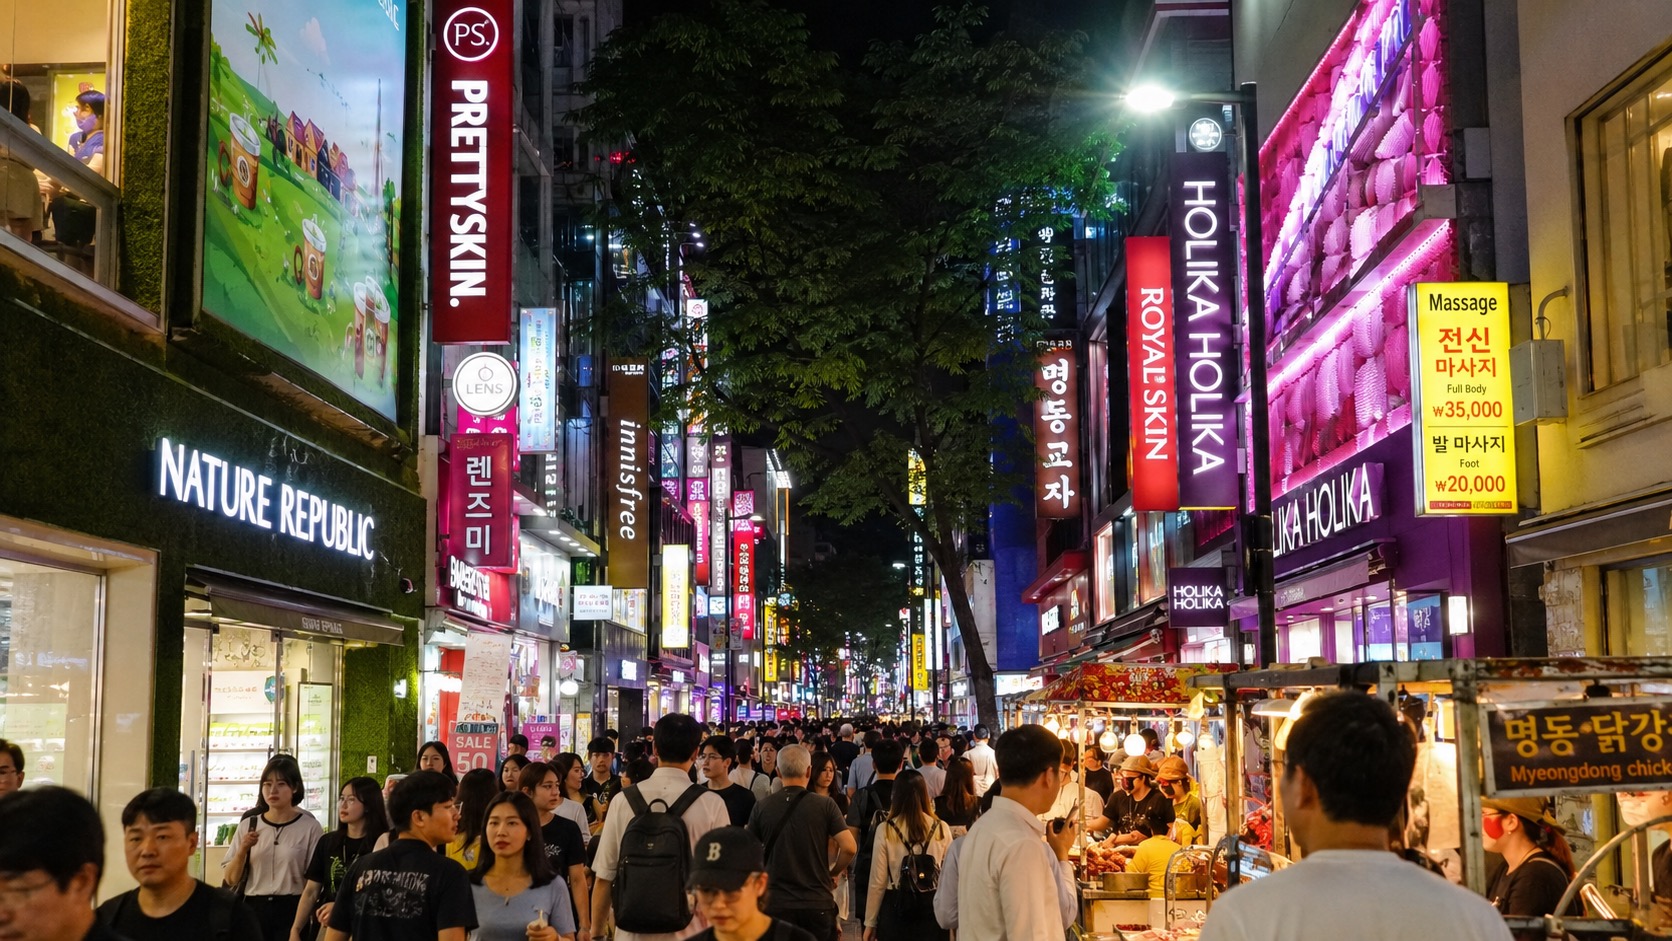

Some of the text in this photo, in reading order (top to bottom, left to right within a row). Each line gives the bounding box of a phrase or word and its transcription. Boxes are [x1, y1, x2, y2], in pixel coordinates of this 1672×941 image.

[450, 80, 488, 308] PRETTYSKIN.
[1183, 180, 1220, 322] HOLIKA
[1429, 293, 1498, 316] Massage
[1438, 327, 1491, 354] 전신
[1140, 287, 1169, 460] ROYAL SKIN
[1435, 357, 1497, 378] 마사지
[466, 383, 503, 395] LENS
[1447, 384, 1487, 396] Full Body
[1188, 333, 1225, 476] HOLIKA
[1432, 401, 1503, 421] ₩35,000
[1041, 358, 1075, 510] 명동교자
[1432, 435, 1506, 454] 발 마사지
[1459, 459, 1480, 469] Foot
[616, 419, 643, 540] innisfree
[1435, 475, 1506, 495] ₩20,000
[160, 437, 375, 560] NATURE REPUBLIC
[465, 455, 493, 555] 렌즈미
[1306, 461, 1375, 543] HOLIKA
[1173, 585, 1223, 598] HOLIKA
[1173, 598, 1224, 610] HOLIKA
[456, 736, 492, 749] SALE
[1590, 709, 1672, 754] 닭강
[1511, 762, 1622, 785] Myeongdong
[706, 842, 721, 862] B
